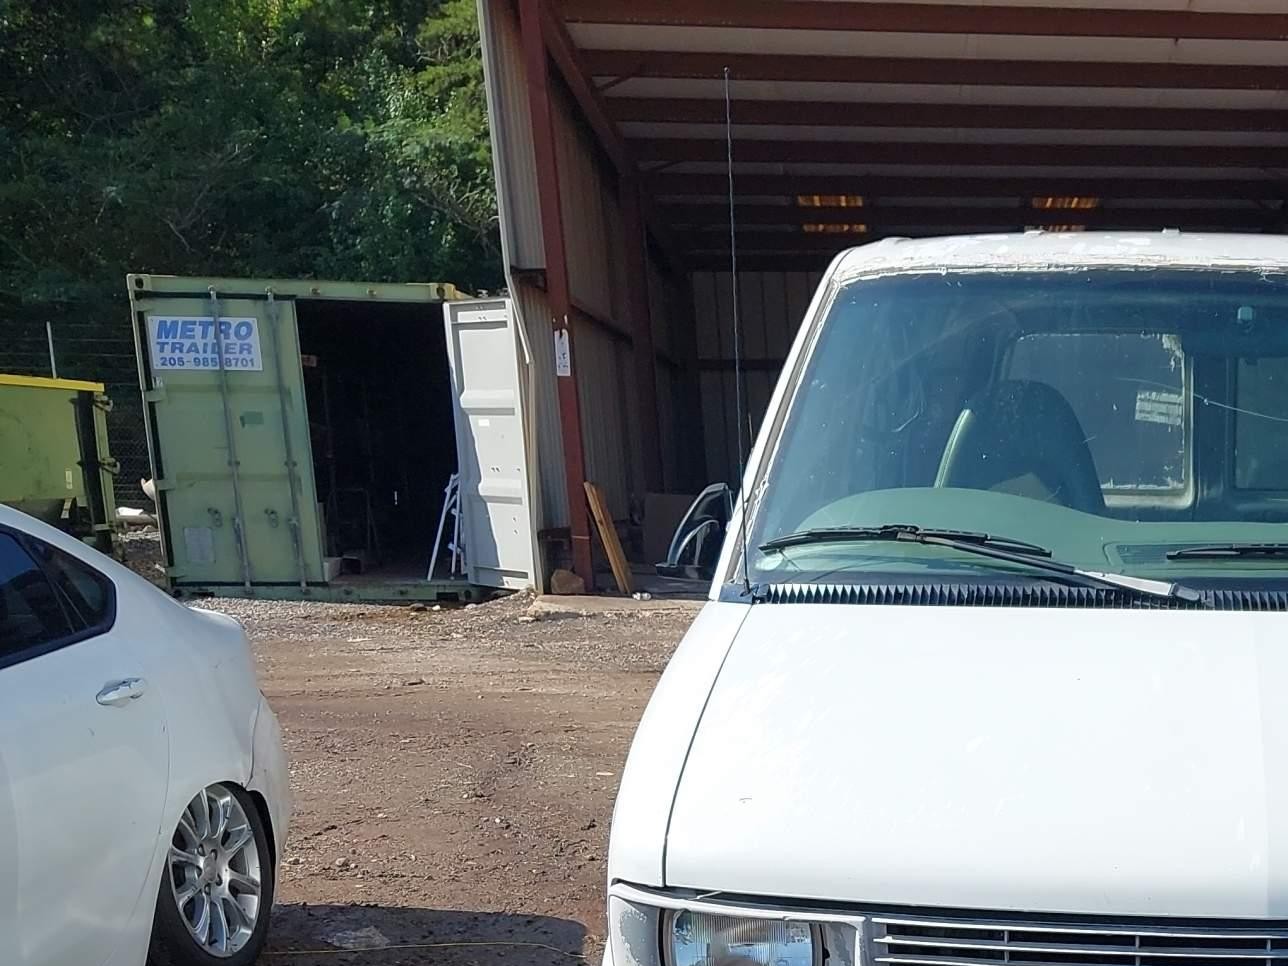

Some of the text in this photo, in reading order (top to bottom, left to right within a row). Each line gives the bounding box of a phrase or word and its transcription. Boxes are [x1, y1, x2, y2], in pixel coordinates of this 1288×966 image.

[157, 320, 253, 340] METRO
[156, 342, 253, 354] TRAILER
[160, 356, 255, 367] 205-9858701
